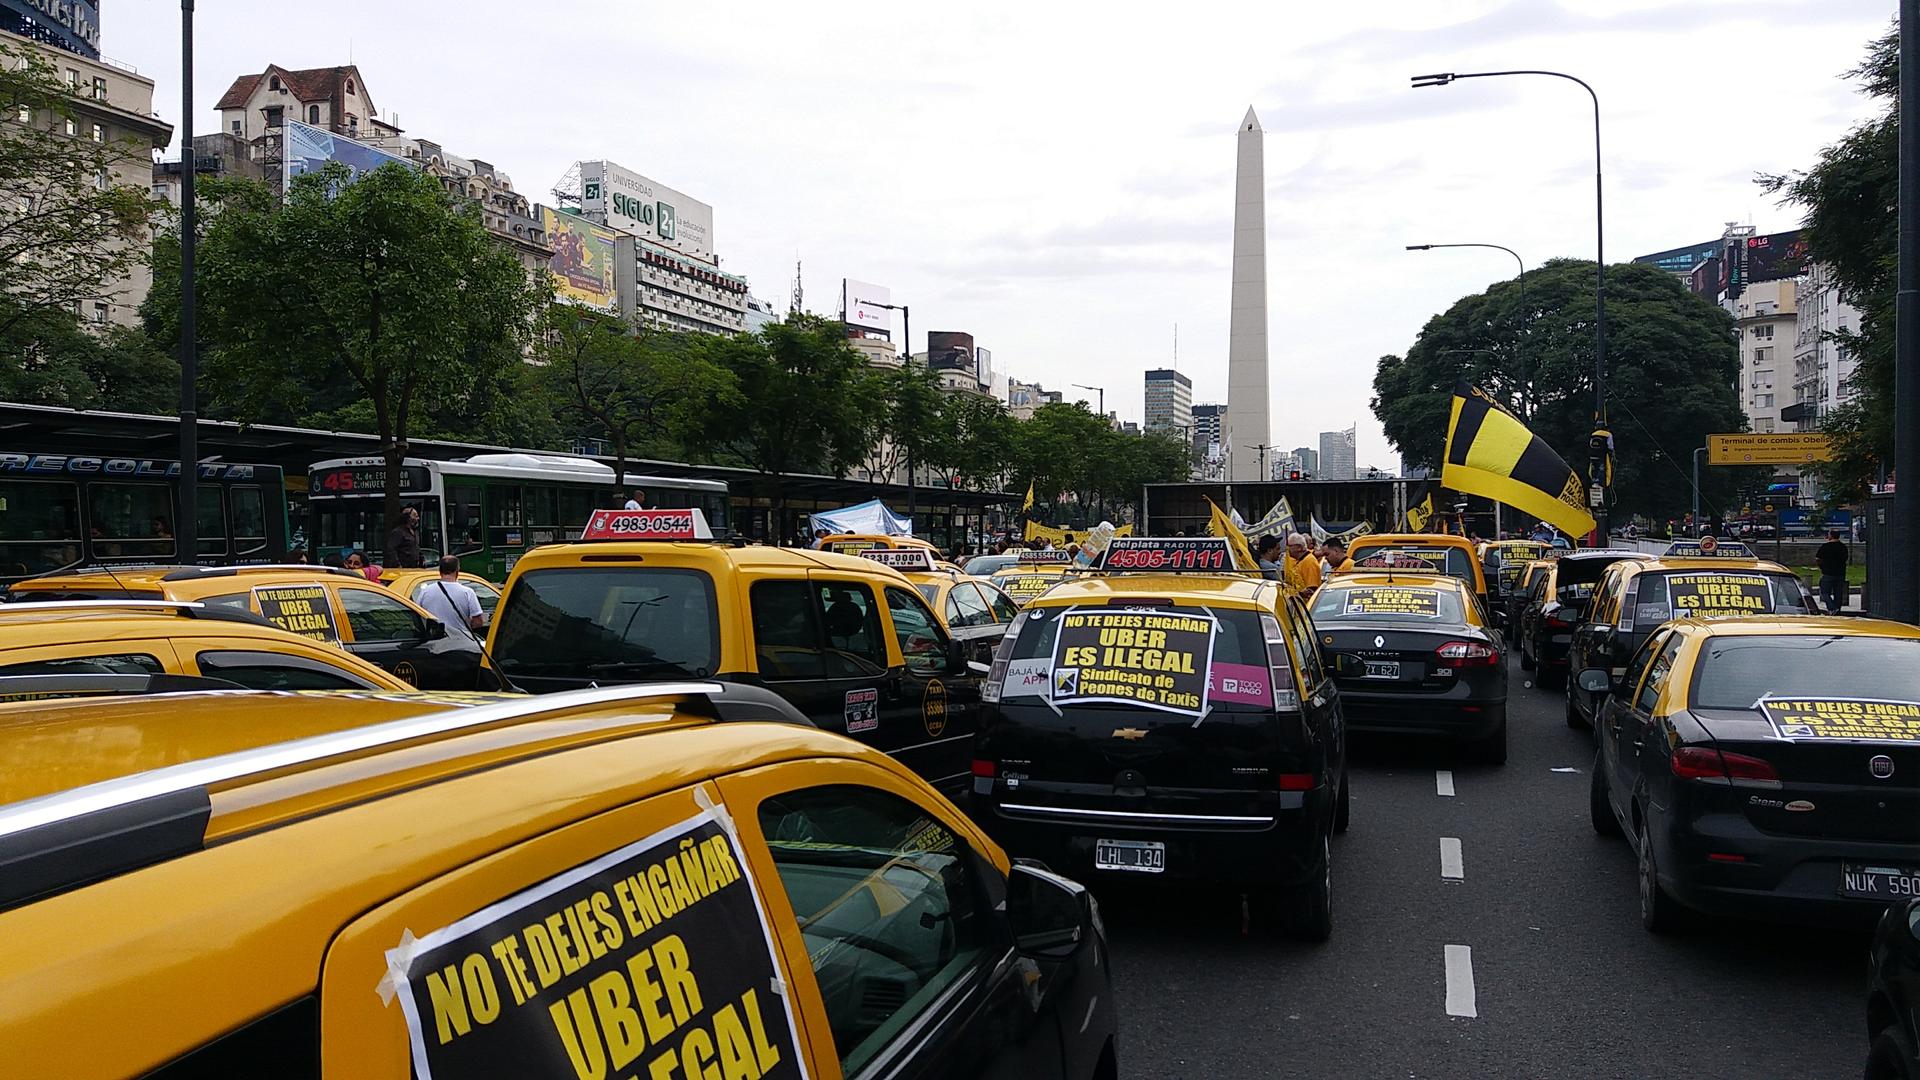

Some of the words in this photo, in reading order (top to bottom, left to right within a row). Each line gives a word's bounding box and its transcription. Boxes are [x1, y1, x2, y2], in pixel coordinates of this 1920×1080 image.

[587, 187, 598, 197] 21
[613, 173, 652, 197] UNIVERSIDAD
[613, 192, 654, 225] SIGLO
[661, 209, 673, 239] 21
[677, 216, 682, 225] La
[646, 251, 683, 274] HOTEL
[324, 472, 353, 490] 45
[611, 517, 691, 531] 4983-0544
[1108, 550, 1224, 568] 4505-1111
[1725, 576, 1766, 586] ENGAÑAR
[258, 591, 268, 601] NO
[268, 591, 277, 600] TE
[276, 589, 296, 600] DEJES
[295, 587, 324, 599] ENGAÑAR
[1697, 584, 1742, 595] UBER
[279, 600, 312, 616] UBER
[1677, 596, 1699, 607] ES
[1704, 595, 1765, 609] ILEGAL
[1692, 609, 1740, 617] Sindicato
[287, 614, 330, 632] ILEGAL
[1065, 615, 1084, 627] NO
[1087, 615, 1101, 627] TE
[1103, 616, 1140, 628] DEJES
[1145, 616, 1209, 633] ENGAÑAR
[1099, 628, 1167, 648] UBER
[1064, 647, 1098, 666] ES
[1103, 648, 1196, 674] ILEGAL
[1009, 665, 1032, 676] BAJÁ
[1035, 667, 1047, 675] LA
[1381, 665, 1398, 676] 627
[1022, 676, 1047, 685] APP
[1080, 668, 1152, 686] Sindicato
[1155, 674, 1174, 688] de
[1239, 680, 1263, 689] TODO
[1079, 681, 1133, 697] Peones
[1136, 687, 1155, 701] de
[1159, 690, 1200, 708] Taxis
[1239, 687, 1262, 695] PAGO
[1767, 702, 1790, 711] NO
[1792, 702, 1813, 711] TE
[1815, 702, 1863, 713] DEJES
[1783, 716, 1826, 724] ES
[1814, 725, 1903, 733] Sindicato
[1816, 730, 1888, 738] Peones
[1874, 761, 1890, 773] FIAT
[1099, 847, 1125, 864] LHL
[1135, 849, 1162, 867] 134
[1845, 873, 1878, 892] NUK
[1888, 875, 1920, 896] 590
[426, 952, 501, 1045] NO
[493, 934, 537, 1006] TE
[522, 891, 624, 989] DEJES
[614, 834, 741, 938] ENGAÑAR
[549, 934, 703, 1080] UBER
[626, 987, 780, 1080] EGAL
